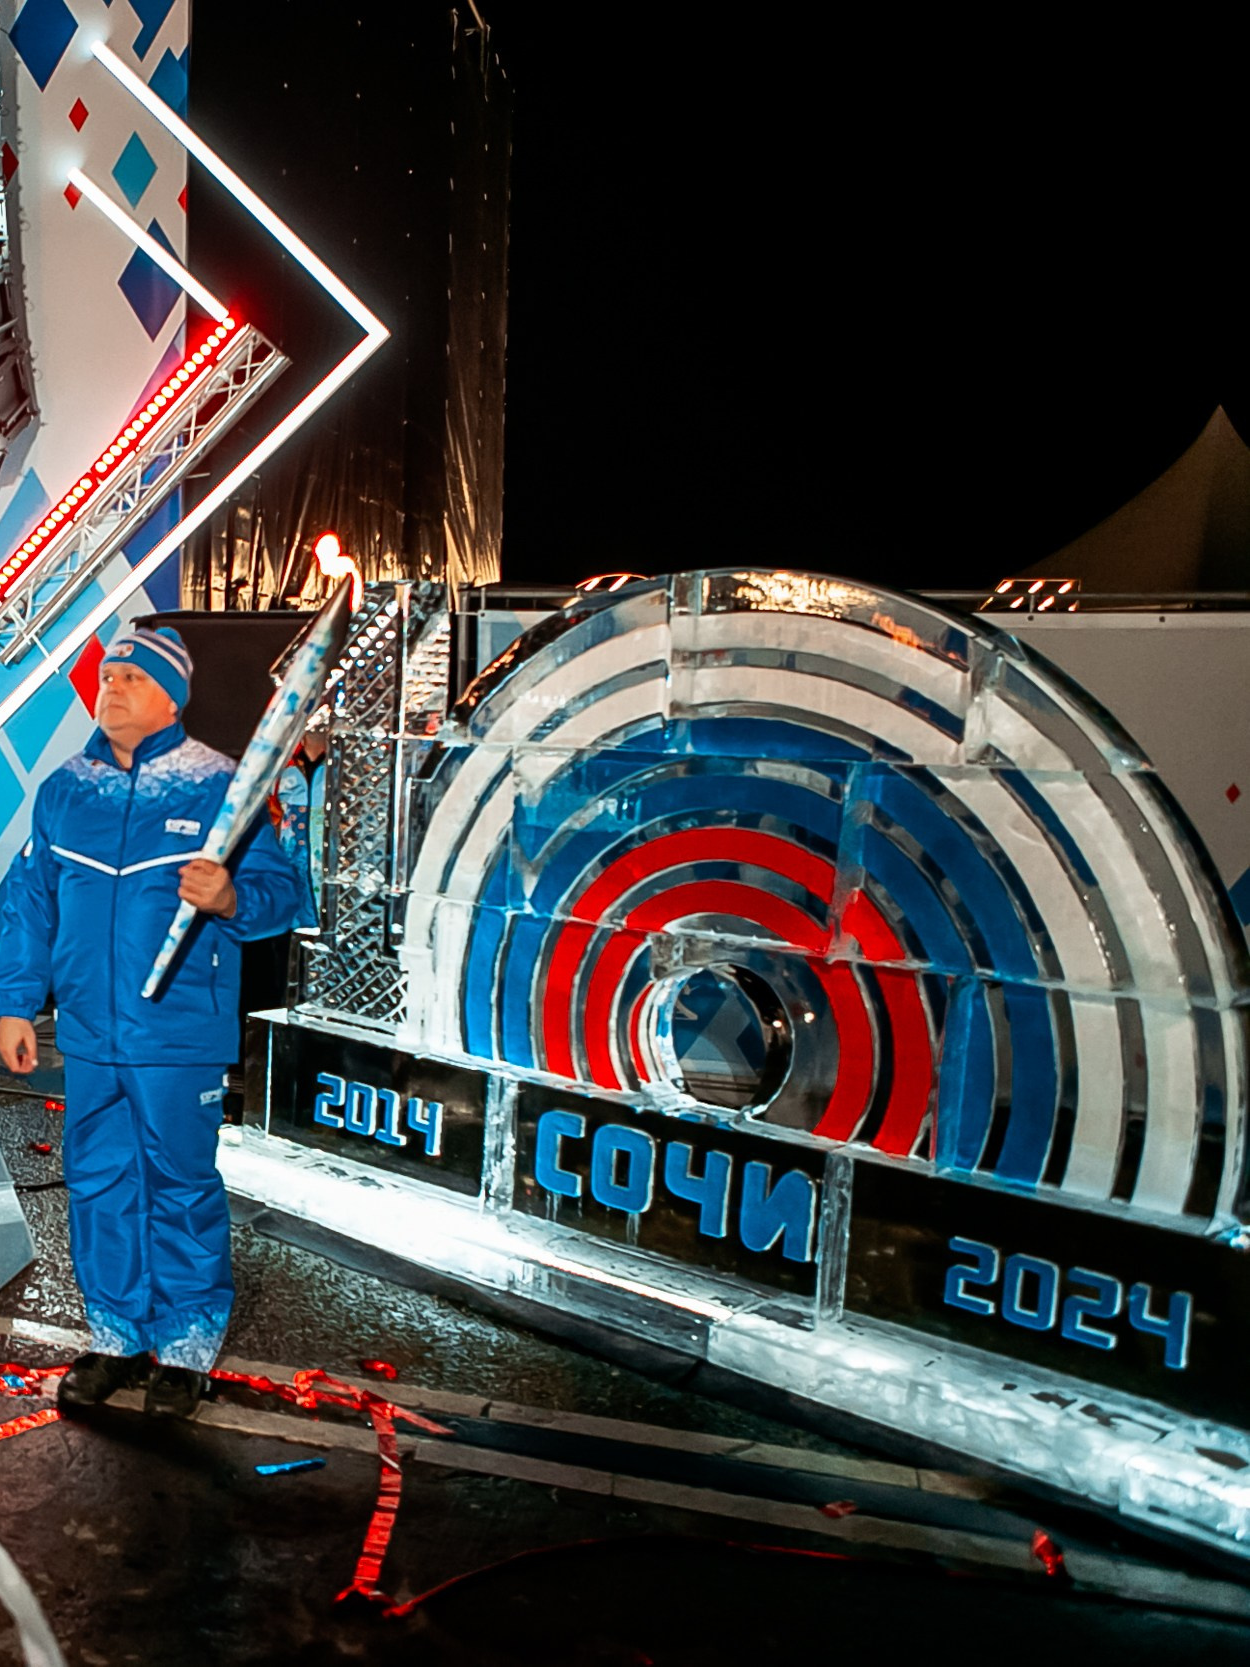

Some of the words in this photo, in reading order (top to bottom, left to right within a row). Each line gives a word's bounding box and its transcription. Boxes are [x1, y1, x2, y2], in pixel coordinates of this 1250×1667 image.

[314, 1071, 444, 1156] 2014
[535, 1109, 819, 1264] СОЧИ
[943, 1235, 1194, 1371] 2024
